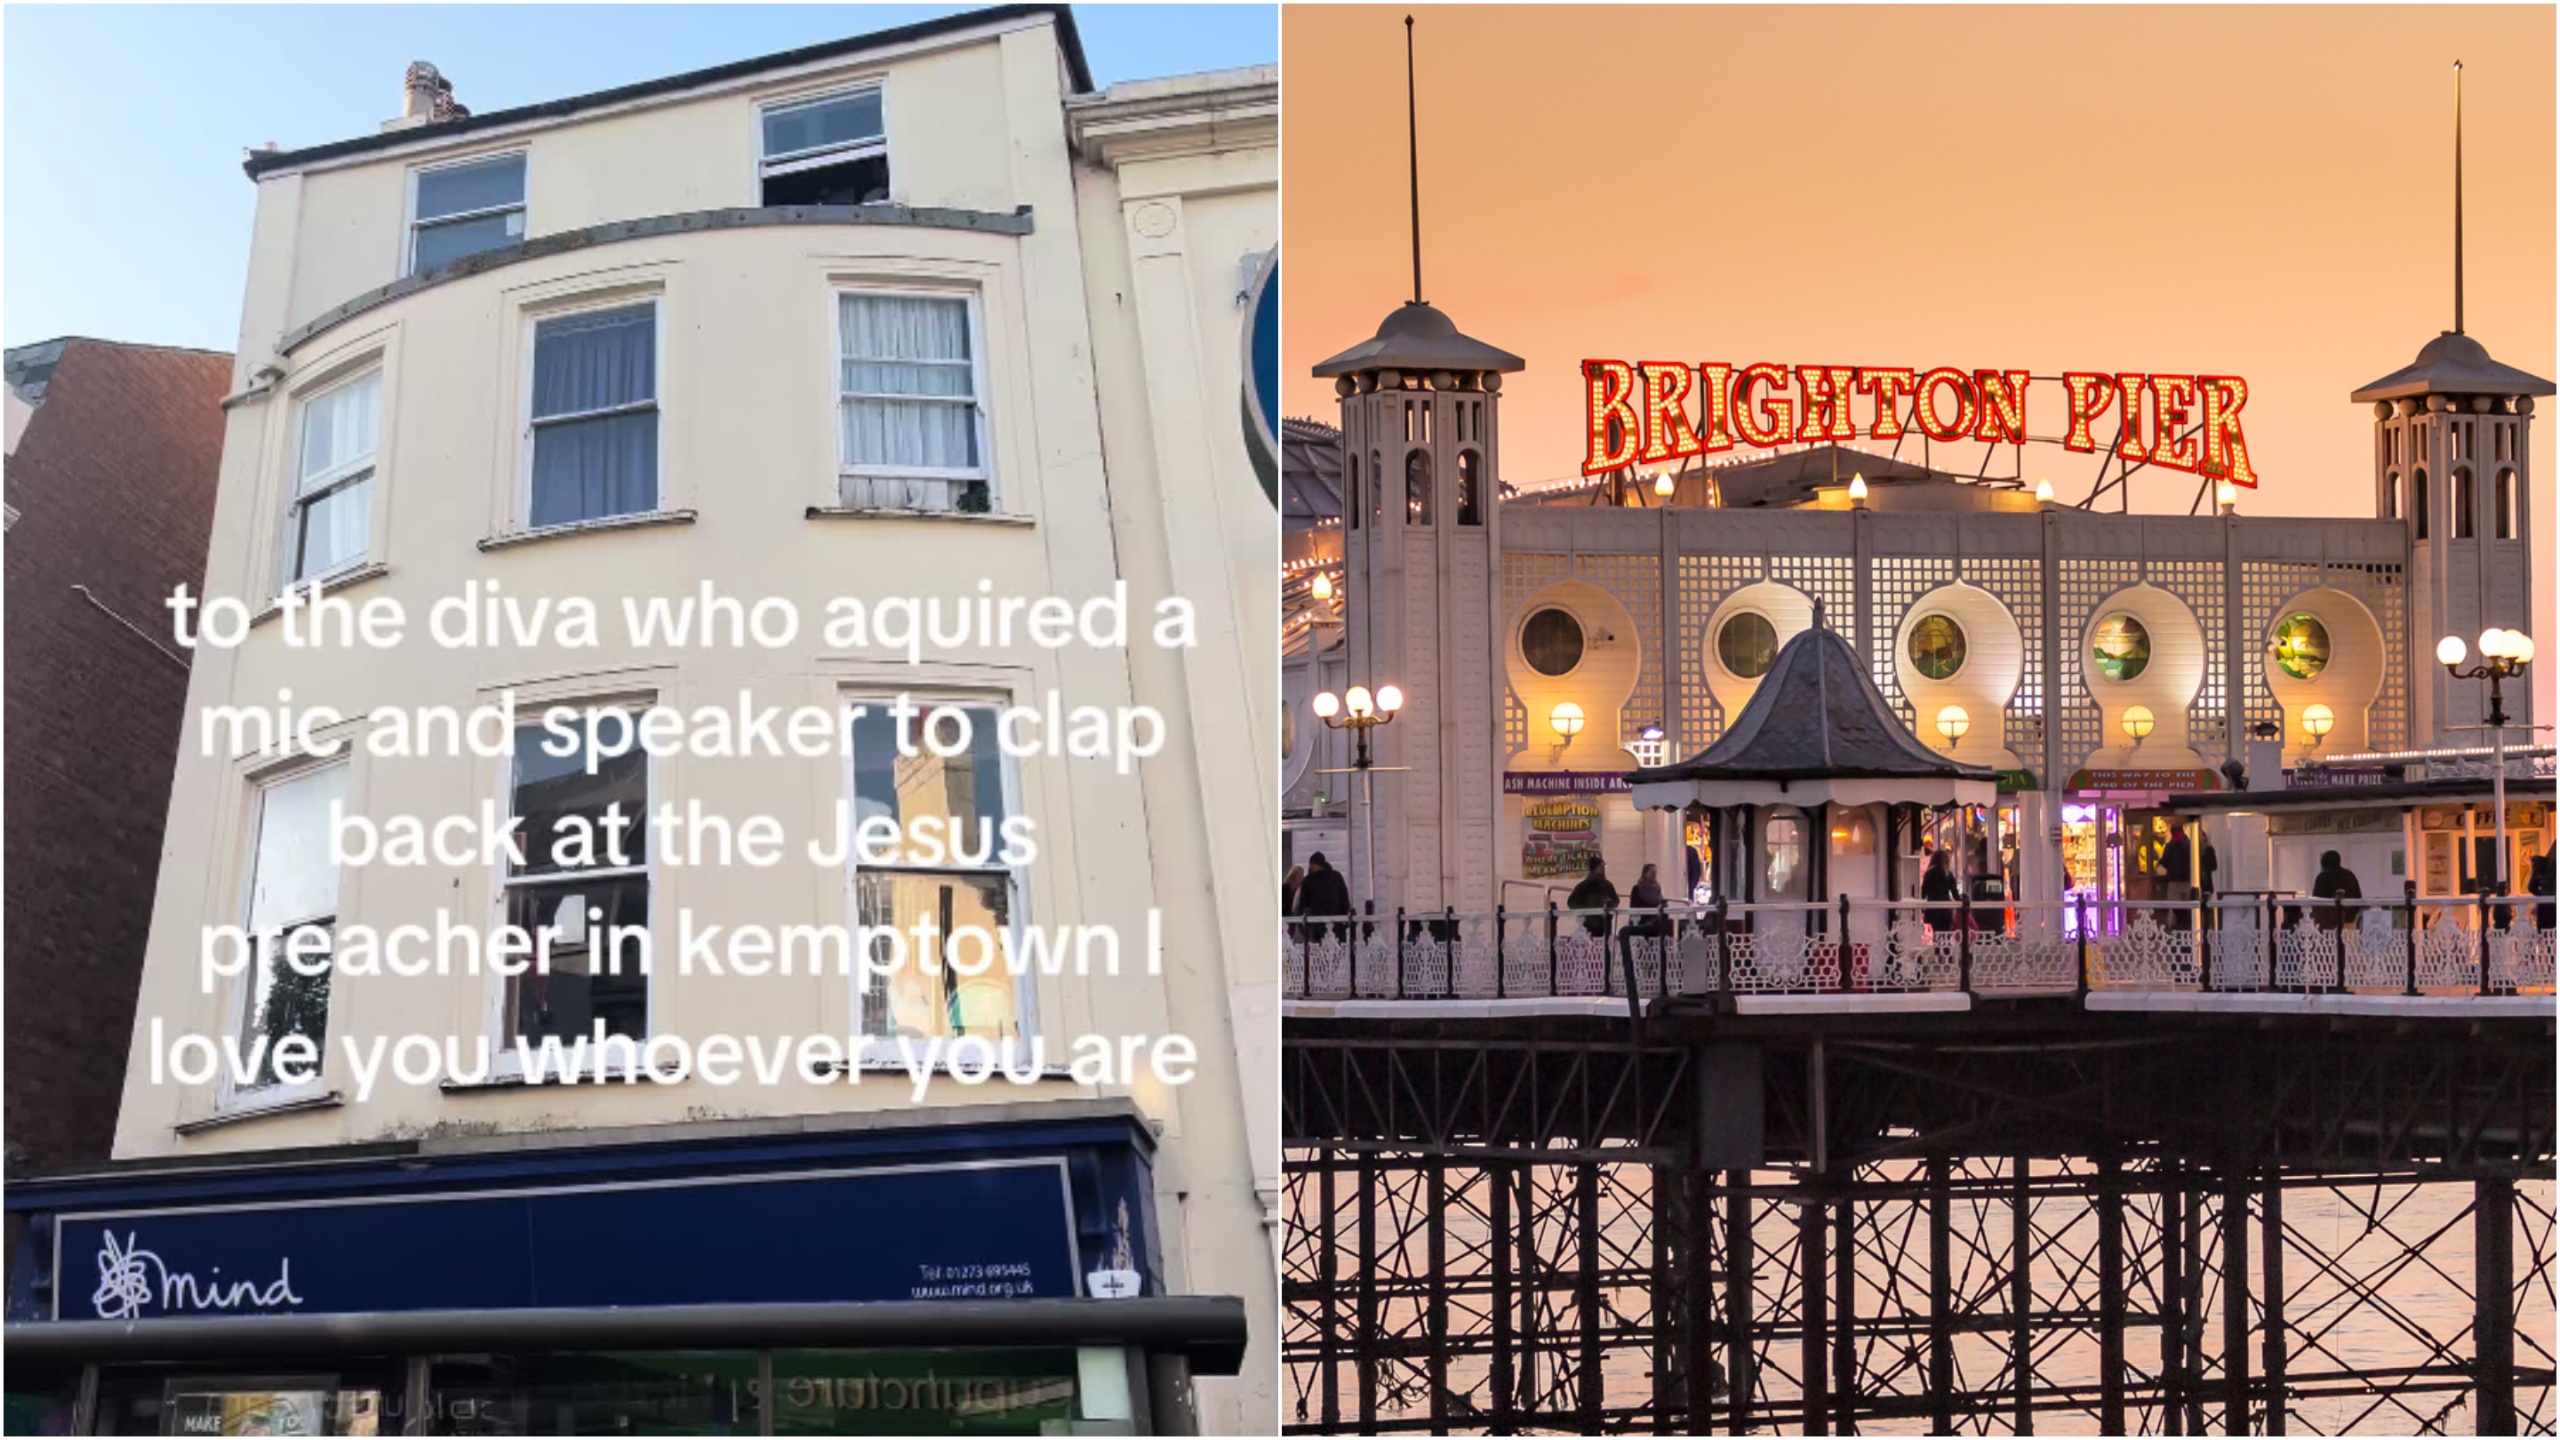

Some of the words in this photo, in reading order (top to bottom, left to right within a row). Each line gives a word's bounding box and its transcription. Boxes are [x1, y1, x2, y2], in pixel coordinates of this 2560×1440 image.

[1581, 358, 2030, 475] BRIGHTON
[2062, 371, 2258, 489] PIER
[1504, 778, 1523, 790] ASH
[1527, 778, 1570, 790] MACHINE
[1574, 778, 1605, 790] INSIDE
[2331, 774, 2355, 786] MAKE
[2358, 774, 2386, 785] PRIZE
[1524, 803, 1599, 817] REDEMPTION
[2456, 808, 2511, 827] CFFE
[1532, 818, 1592, 832] MACHINES
[1524, 854, 1558, 863] WHERE
[1560, 861, 1589, 873] PRIZE
[162, 1256, 304, 1311] mind
[184, 1416, 222, 1432] MAKE
